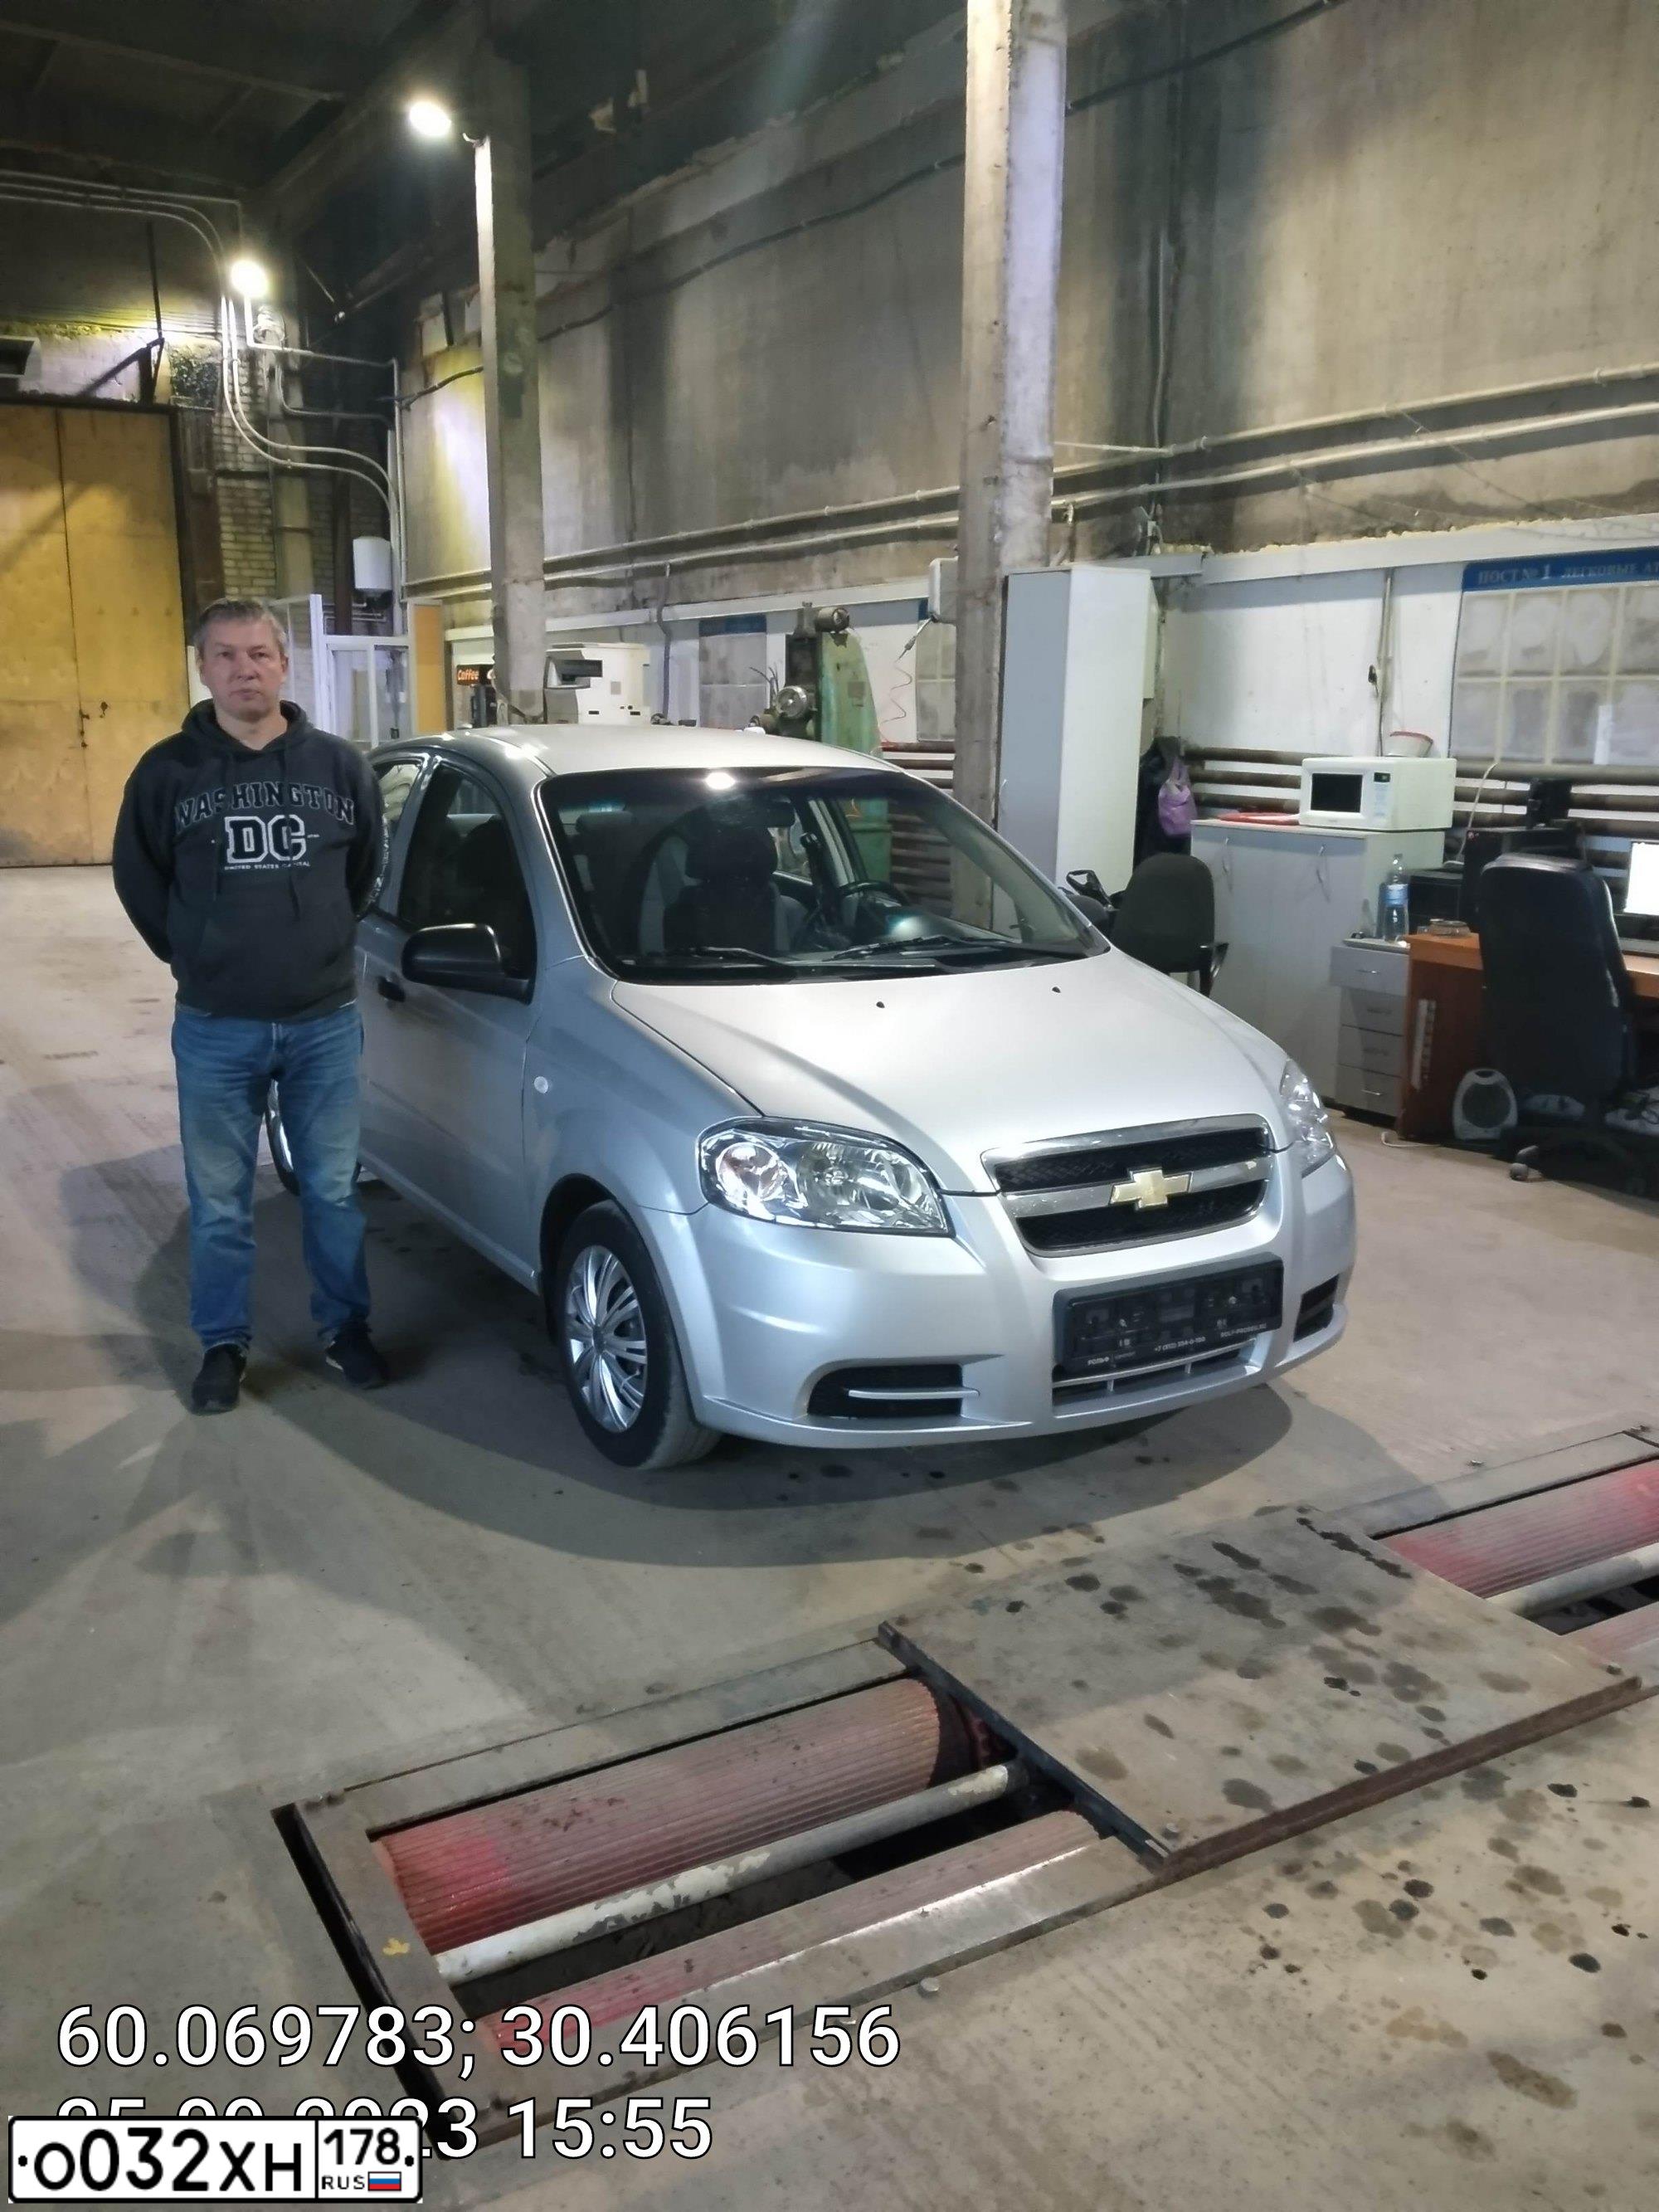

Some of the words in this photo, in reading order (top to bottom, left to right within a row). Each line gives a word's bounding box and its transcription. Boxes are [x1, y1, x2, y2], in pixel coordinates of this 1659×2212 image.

[457, 669, 479, 680] Coffee
[174, 781, 355, 836] WASHINGTON
[224, 814, 307, 863] DC
